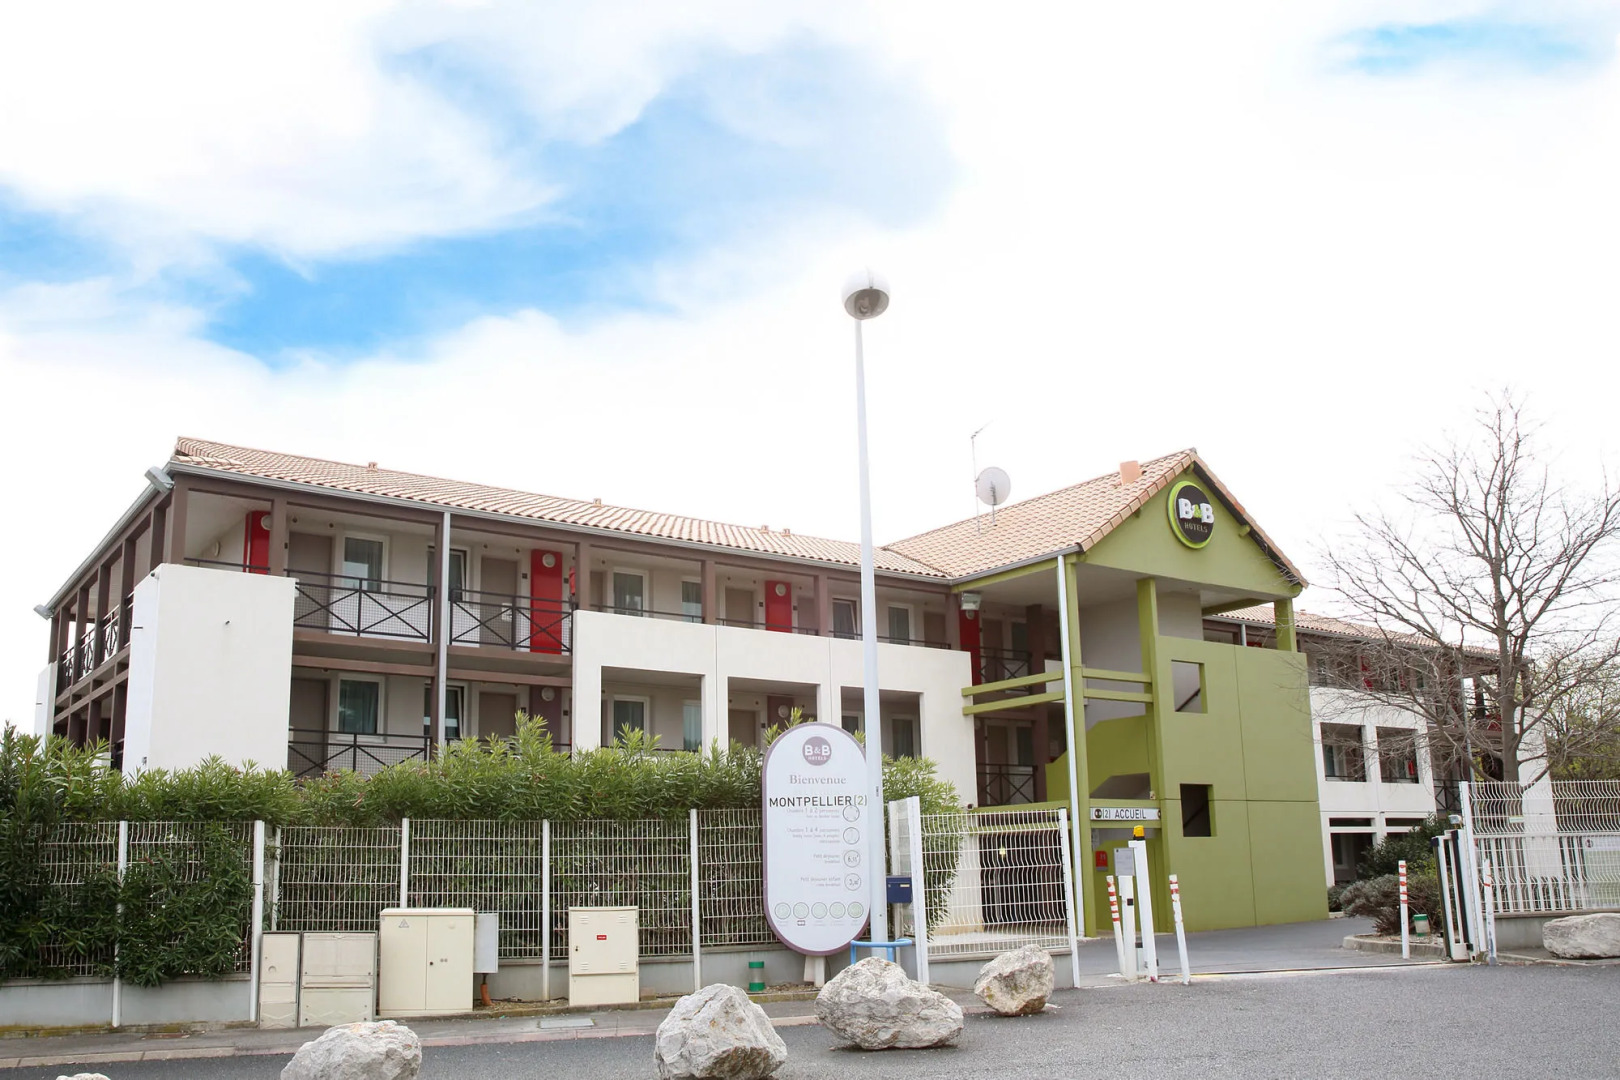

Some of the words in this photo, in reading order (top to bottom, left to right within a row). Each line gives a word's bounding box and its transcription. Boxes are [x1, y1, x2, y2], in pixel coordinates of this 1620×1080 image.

[1178, 498, 1214, 523] B&B
[1184, 522, 1208, 533] HOTELS
[805, 745, 831, 755] B&B
[789, 774, 847, 784] Bienvenue
[1114, 809, 1147, 819] ACCUEIL
